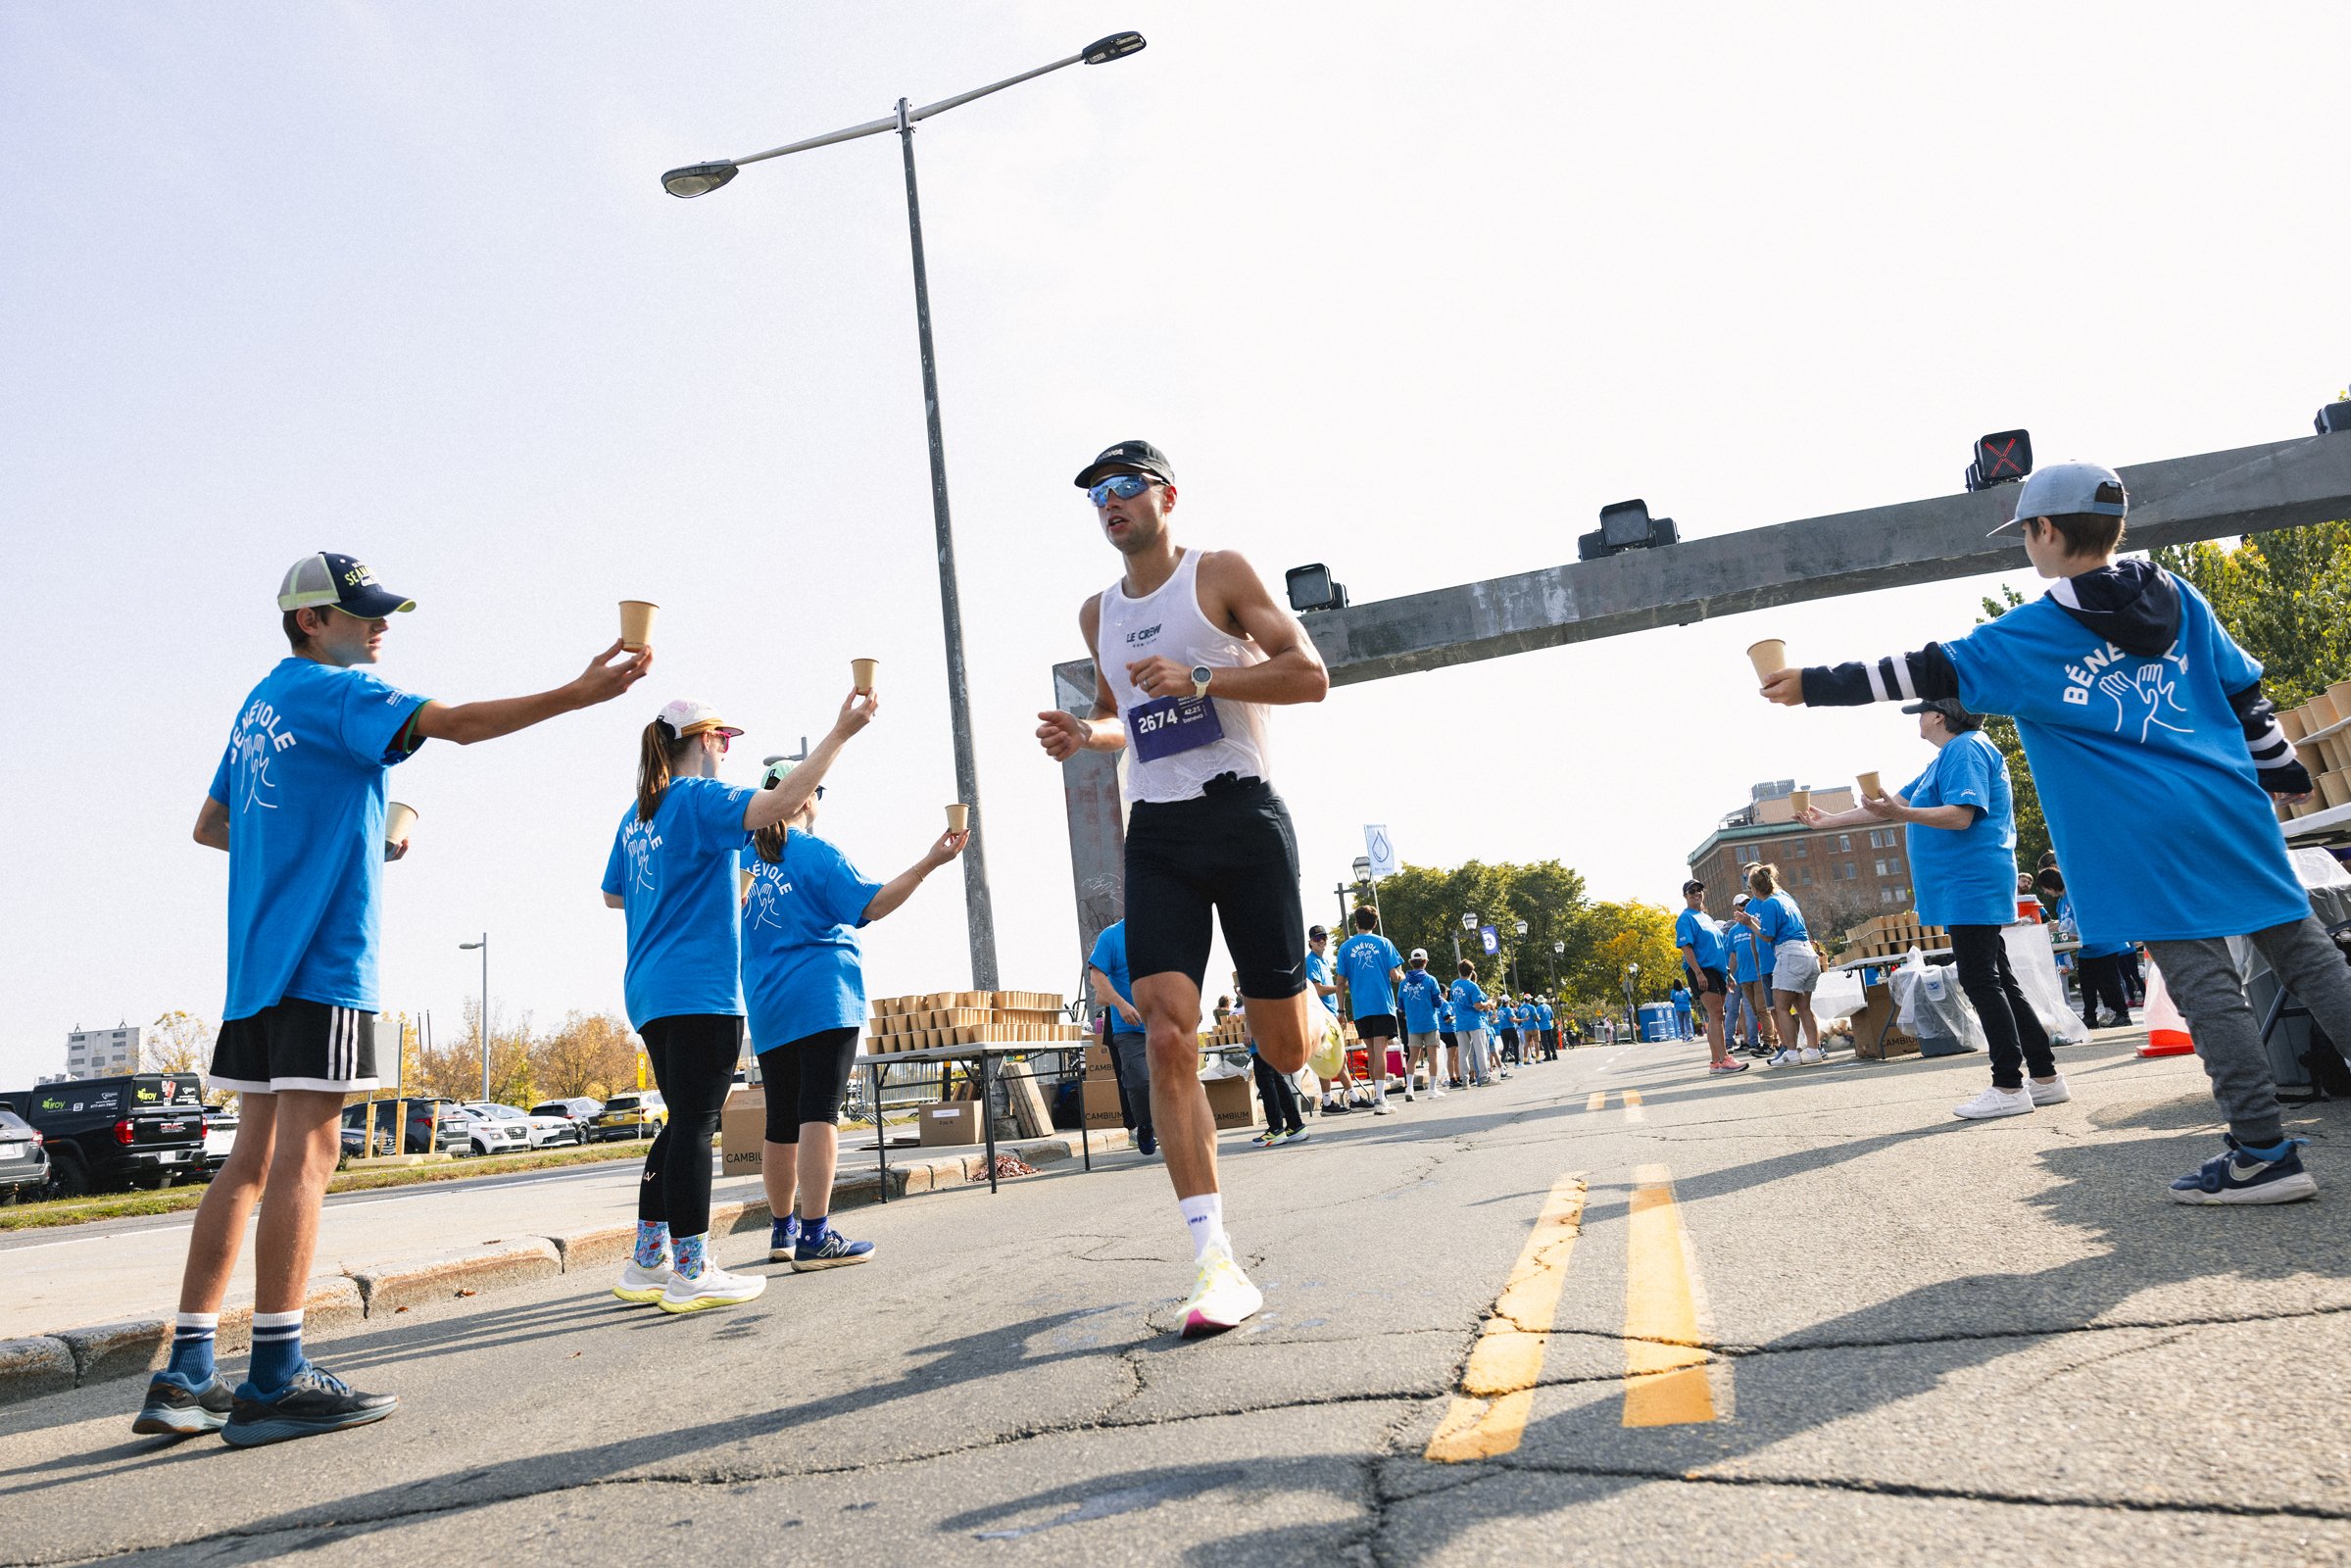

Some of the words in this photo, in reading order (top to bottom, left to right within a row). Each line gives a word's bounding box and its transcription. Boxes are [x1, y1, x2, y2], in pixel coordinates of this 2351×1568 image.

[1126, 632, 1137, 643] LE
[1138, 623, 1162, 640] CREW
[1138, 709, 1178, 734] 2674
[1884, 1037, 1918, 1047] AMBIU
[726, 1152, 763, 1163] CAMBIU
